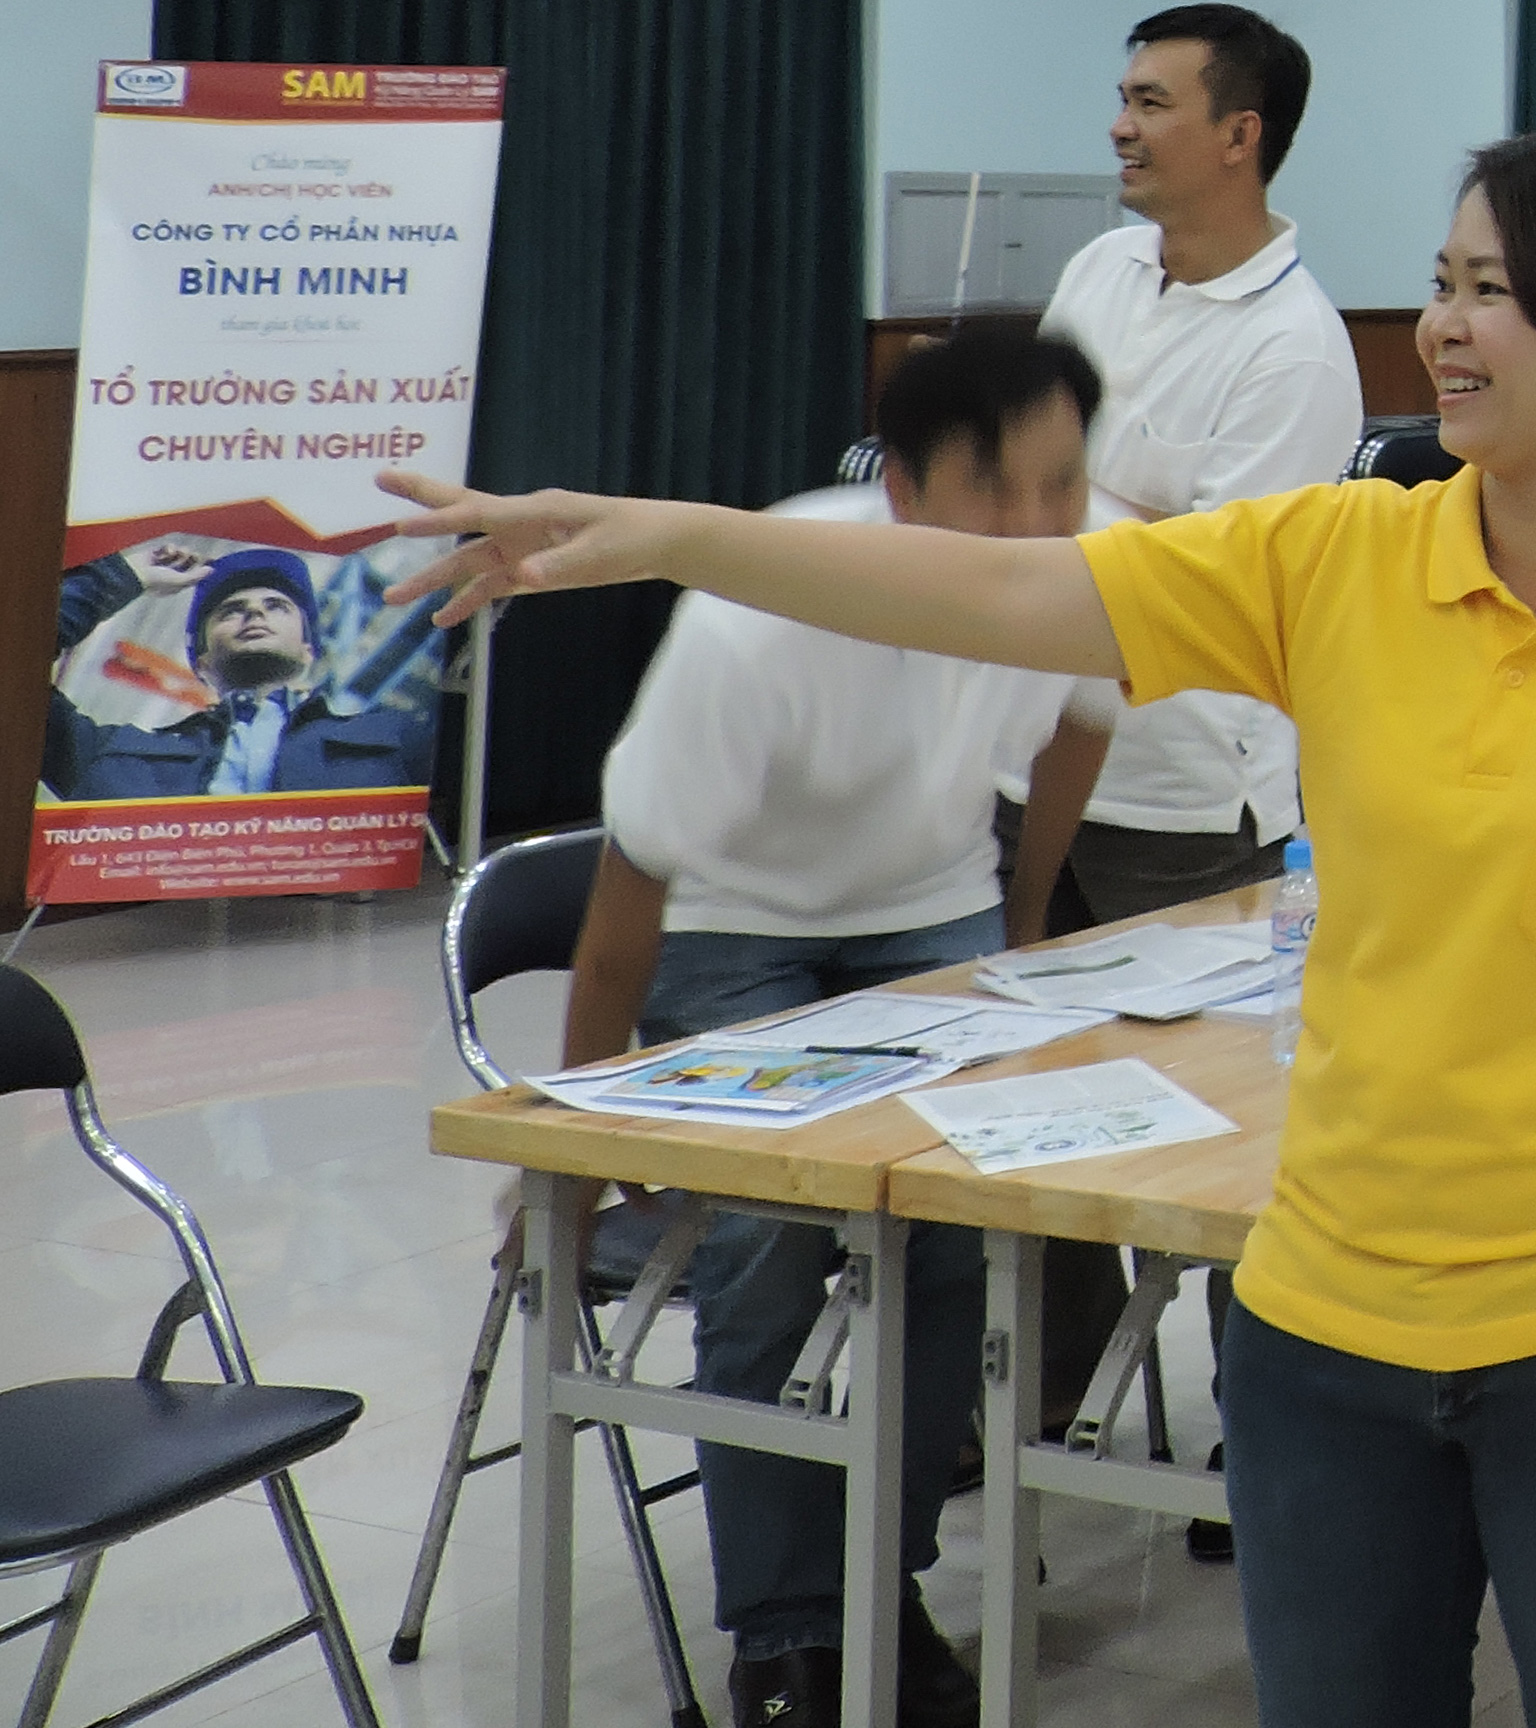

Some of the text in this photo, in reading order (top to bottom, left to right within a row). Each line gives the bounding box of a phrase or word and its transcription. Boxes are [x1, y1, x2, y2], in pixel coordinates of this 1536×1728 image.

[281, 69, 366, 99] SAM
[132, 220, 213, 241] CÔNG
[222, 224, 249, 241] TY
[259, 215, 300, 241] CỔ
[387, 223, 459, 247] NHỰA
[179, 259, 409, 295] BÌNH MINH
[90, 365, 470, 405] TỔ TRƯỞNG SẢN XUẤT
[138, 426, 425, 465] CHUYÊN NGHIỆP
